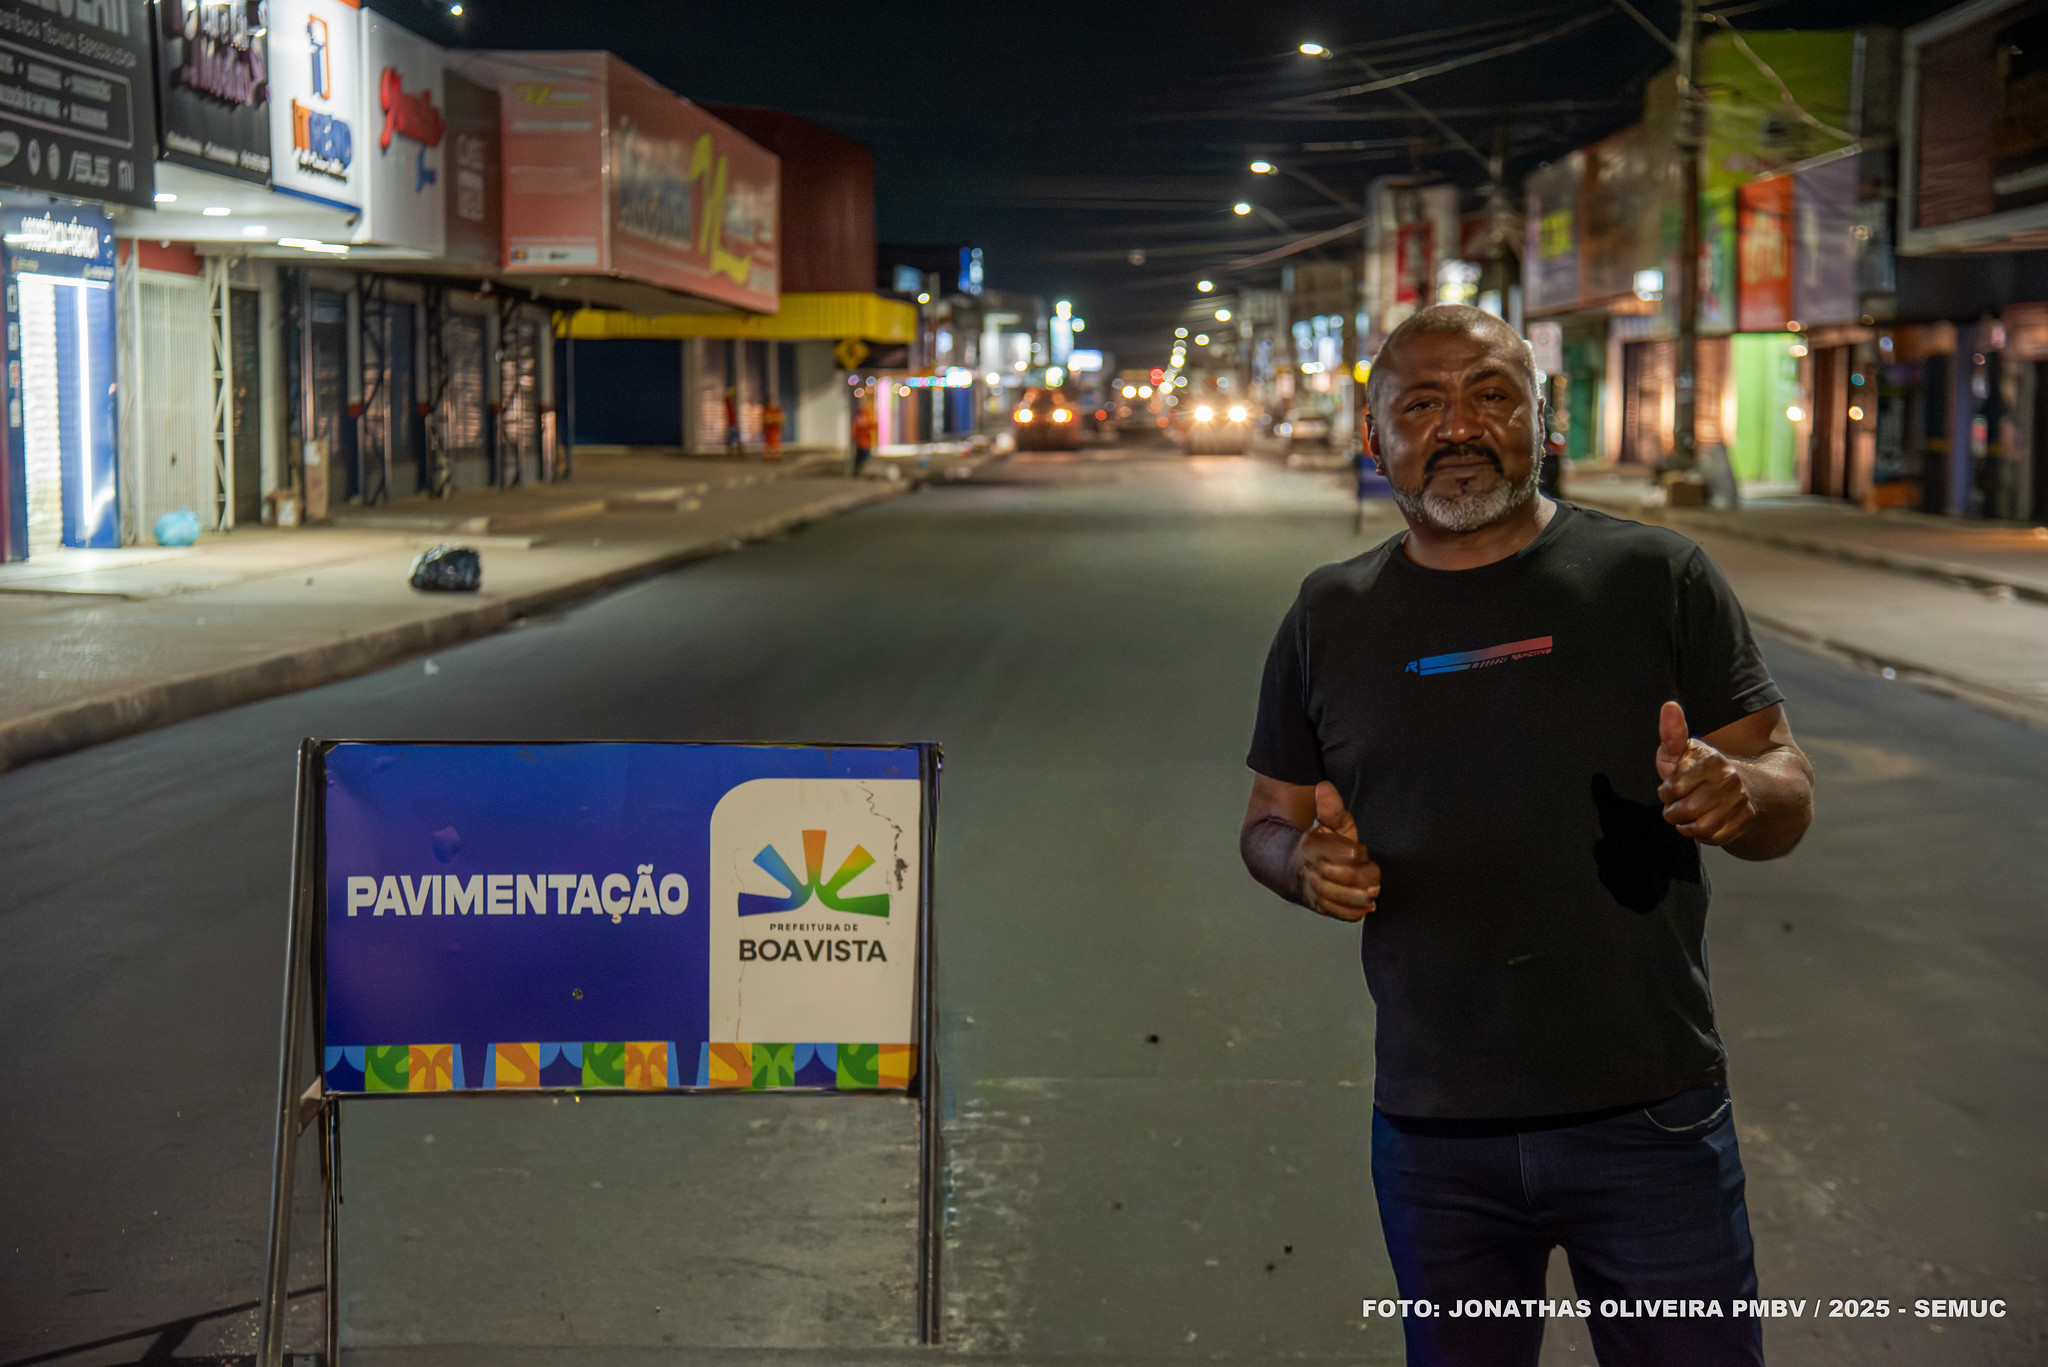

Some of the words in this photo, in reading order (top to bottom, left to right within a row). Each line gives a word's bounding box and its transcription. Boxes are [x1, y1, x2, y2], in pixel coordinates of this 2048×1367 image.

[347, 864, 689, 924] PAVIMENTAÇÃO
[769, 923, 841, 932] PREFEITURA
[844, 923, 859, 932] DE
